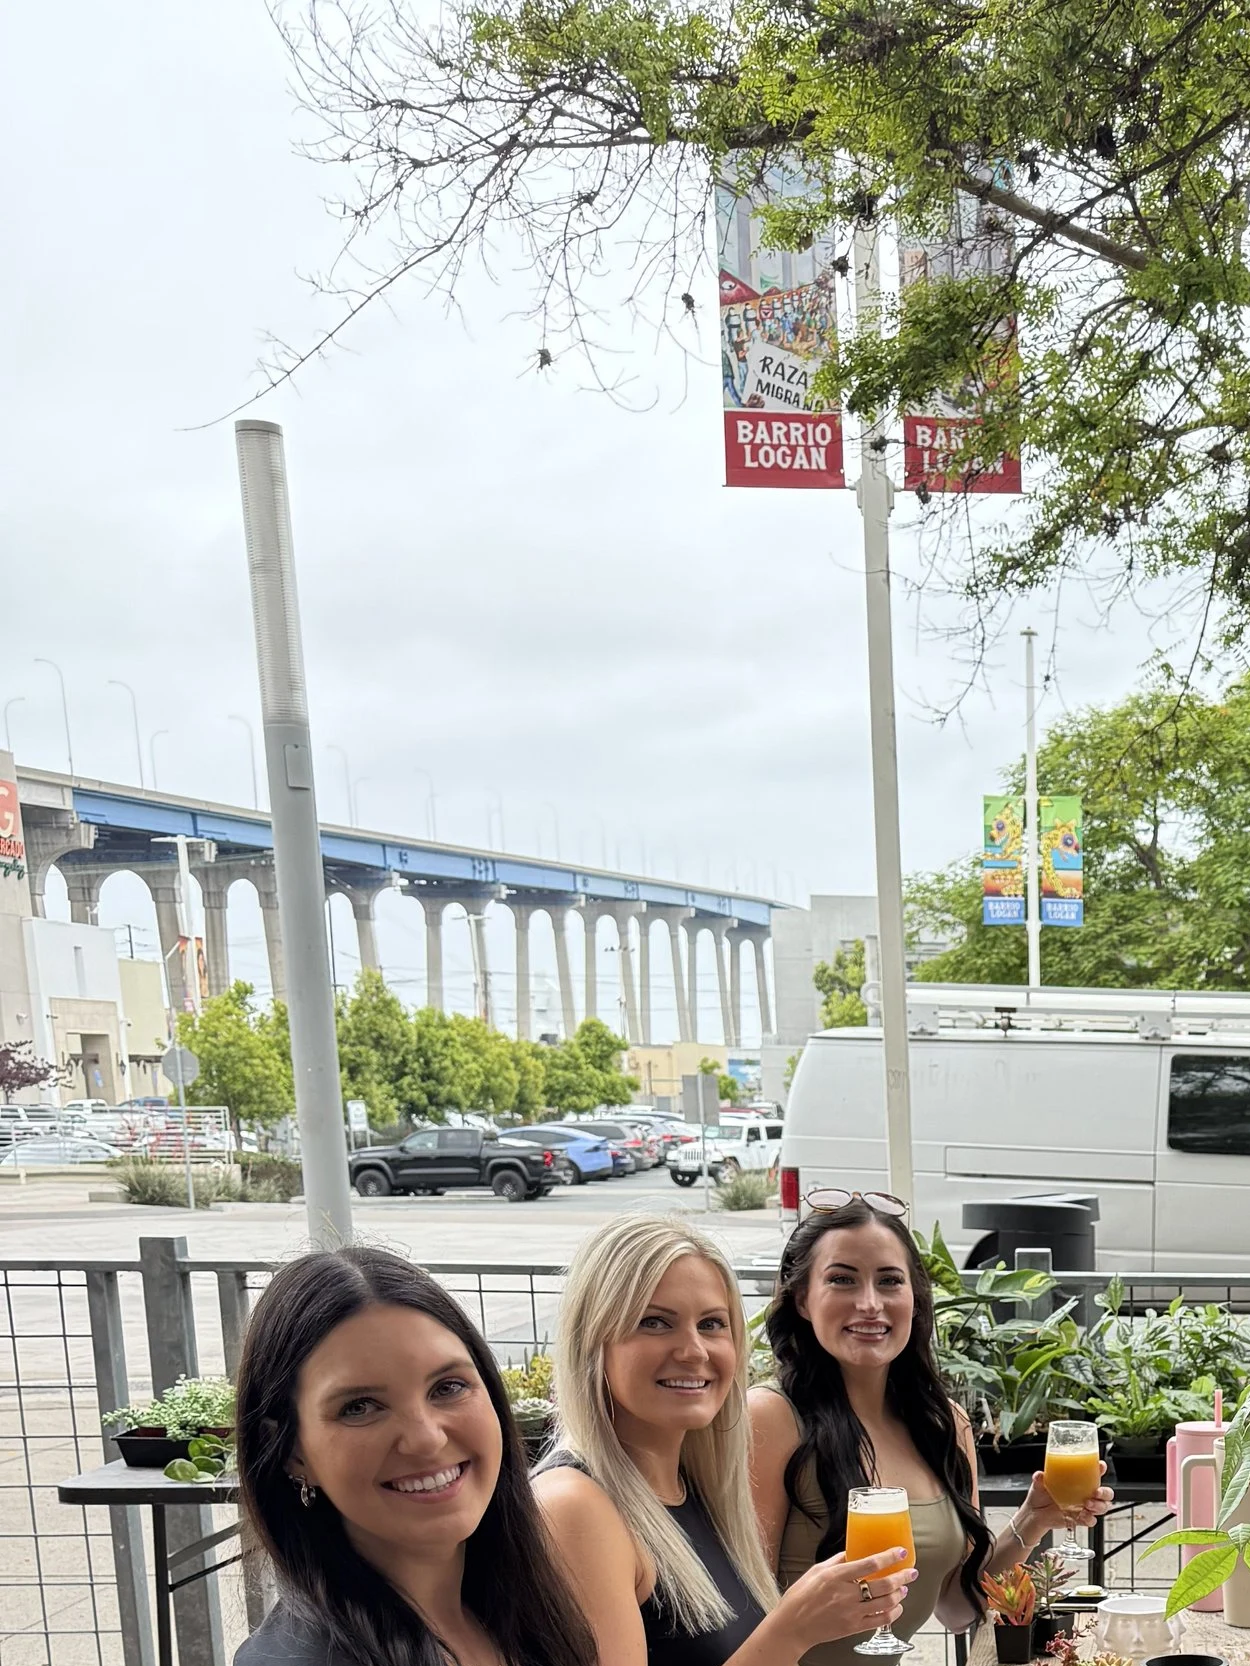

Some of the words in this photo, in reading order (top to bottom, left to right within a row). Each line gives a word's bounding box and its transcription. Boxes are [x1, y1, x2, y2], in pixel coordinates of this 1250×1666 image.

[759, 355, 808, 389] RAZA
[755, 378, 801, 408] MIGRA
[736, 420, 832, 446] BARRIO
[744, 444, 827, 470] LOGAN
